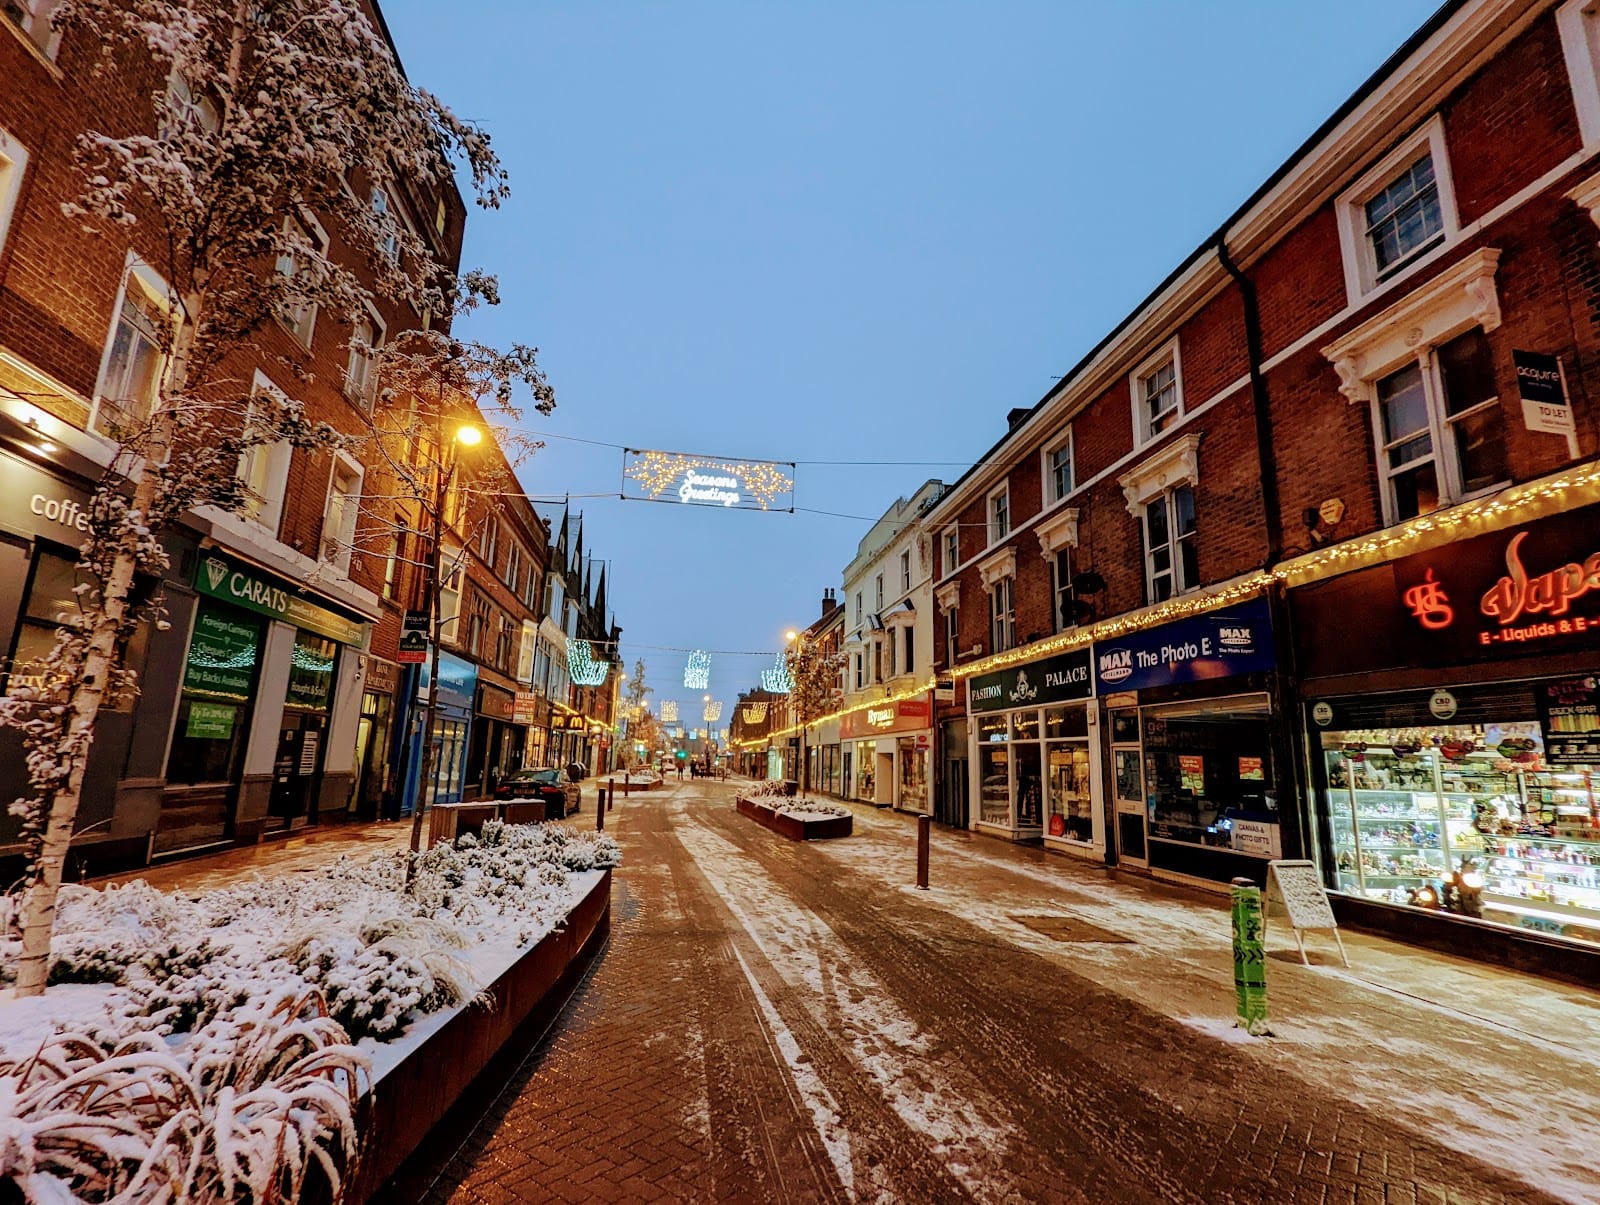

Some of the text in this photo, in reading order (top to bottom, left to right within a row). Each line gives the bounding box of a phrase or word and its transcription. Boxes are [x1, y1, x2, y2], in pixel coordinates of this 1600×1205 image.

[1517, 366, 1559, 381] acquire
[1539, 406, 1567, 419] TO LET
[684, 469, 738, 489] Seasons
[679, 484, 740, 507] Greetings
[230, 572, 287, 613] CARATS
[202, 615, 228, 632] Foreign
[1219, 628, 1251, 639] MAX
[1100, 649, 1132, 671] MAX
[1136, 650, 1158, 669] The
[1161, 641, 1198, 663] Photo
[971, 666, 1088, 701] FASHION PALACE
[867, 708, 894, 726] Ryman
[1238, 823, 1259, 832] CANVAS
[1235, 833, 1254, 843] PHOTO
